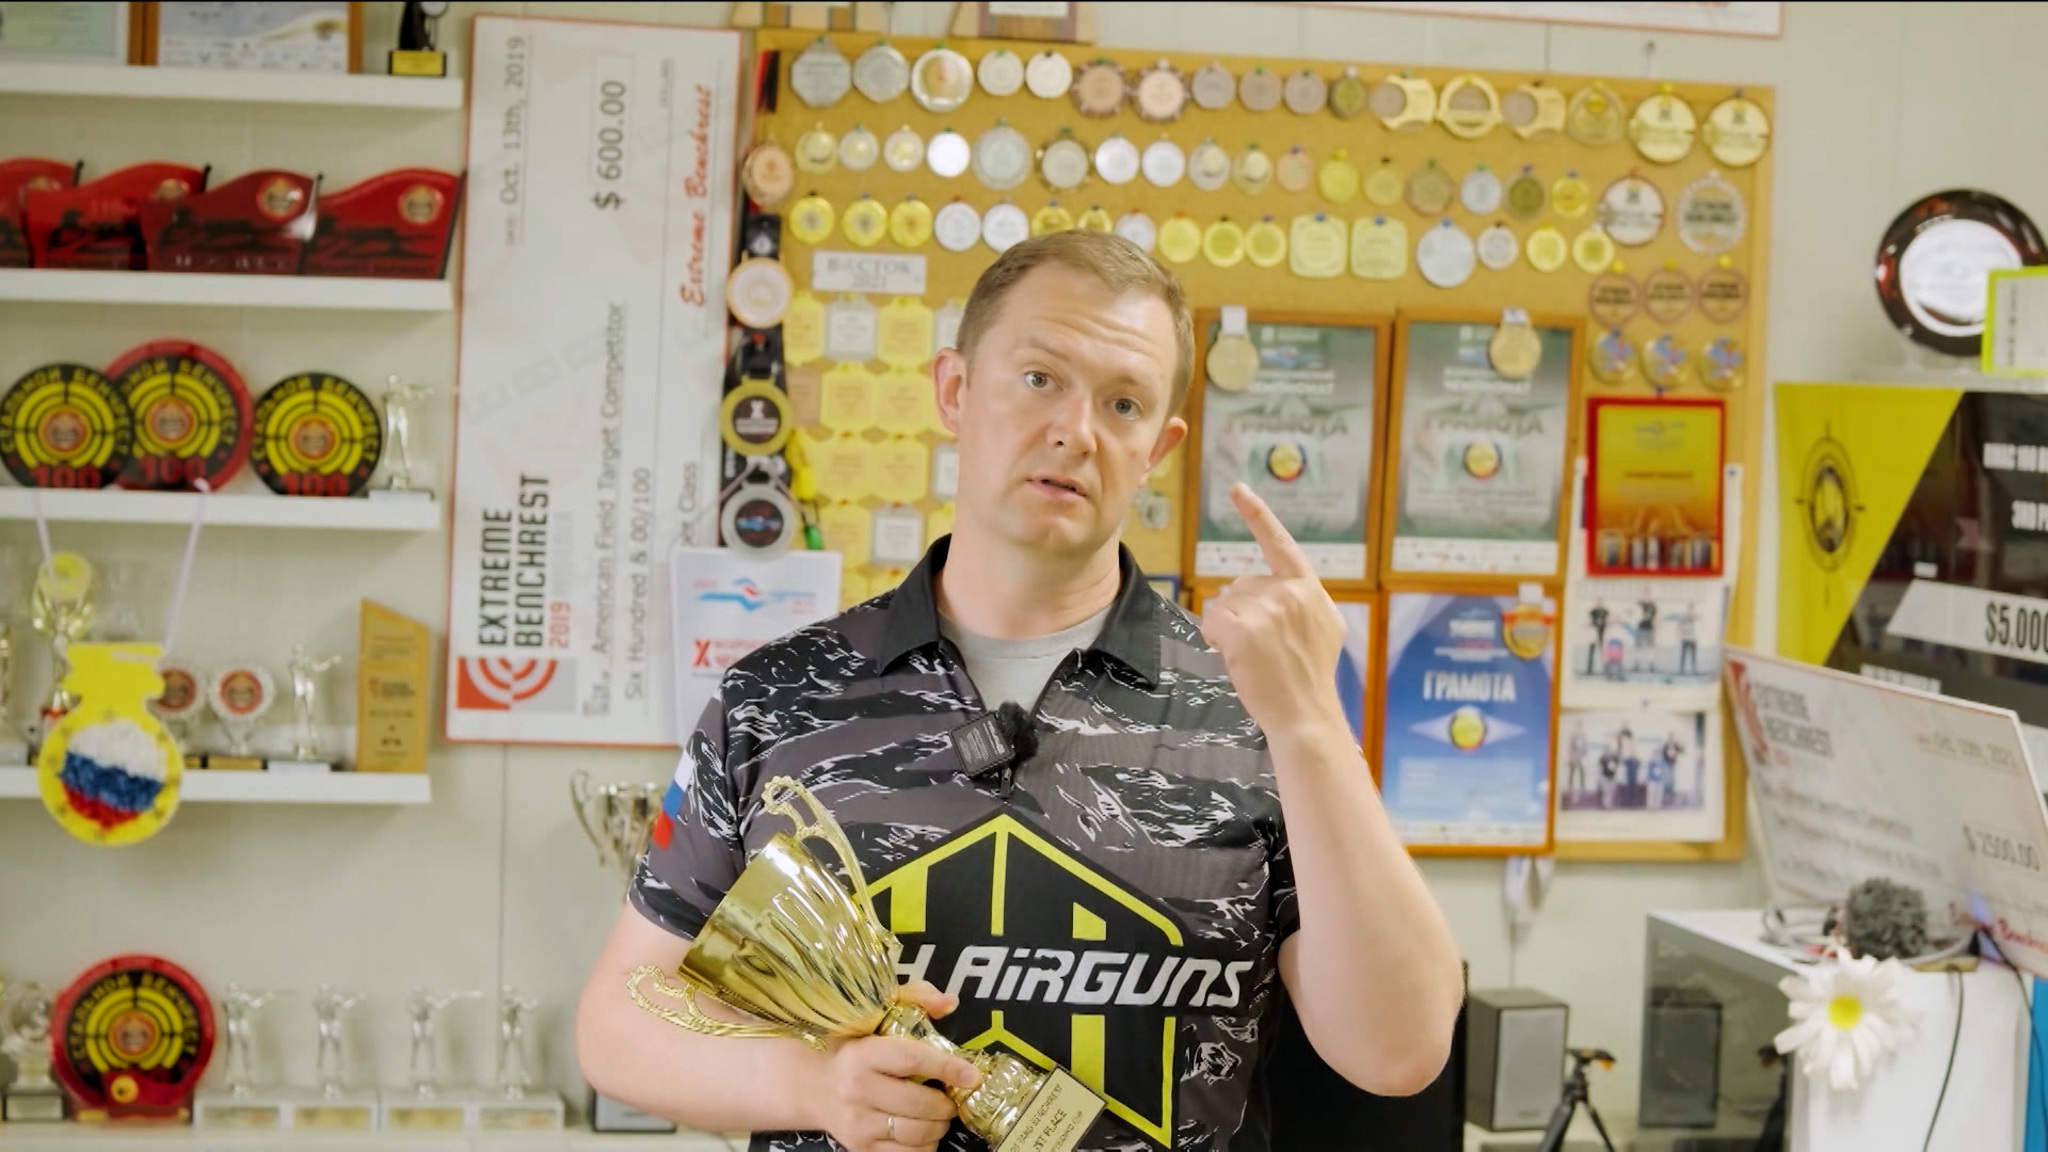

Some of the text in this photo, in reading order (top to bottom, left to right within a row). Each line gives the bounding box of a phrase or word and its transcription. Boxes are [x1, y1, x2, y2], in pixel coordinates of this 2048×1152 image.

[504, 36, 526, 89] 2019
[502, 99, 526, 151] 13th,
[591, 80, 626, 211] $ 600.00
[498, 163, 520, 206] Oct.
[680, 84, 711, 307] Extreme Benchrest
[599, 303, 626, 420] Competitor
[31, 464, 100, 488] 100
[140, 455, 207, 484] 100
[279, 469, 349, 496] 100
[596, 427, 621, 491] Target
[594, 501, 616, 550] Field
[478, 507, 512, 646] EXTREME
[514, 473, 548, 647] BENCHREST
[624, 466, 652, 700] Six Hundred & 00/100
[549, 601, 570, 649] 2019
[591, 558, 616, 655] American
[1424, 671, 1517, 702] ГРАМОТА
